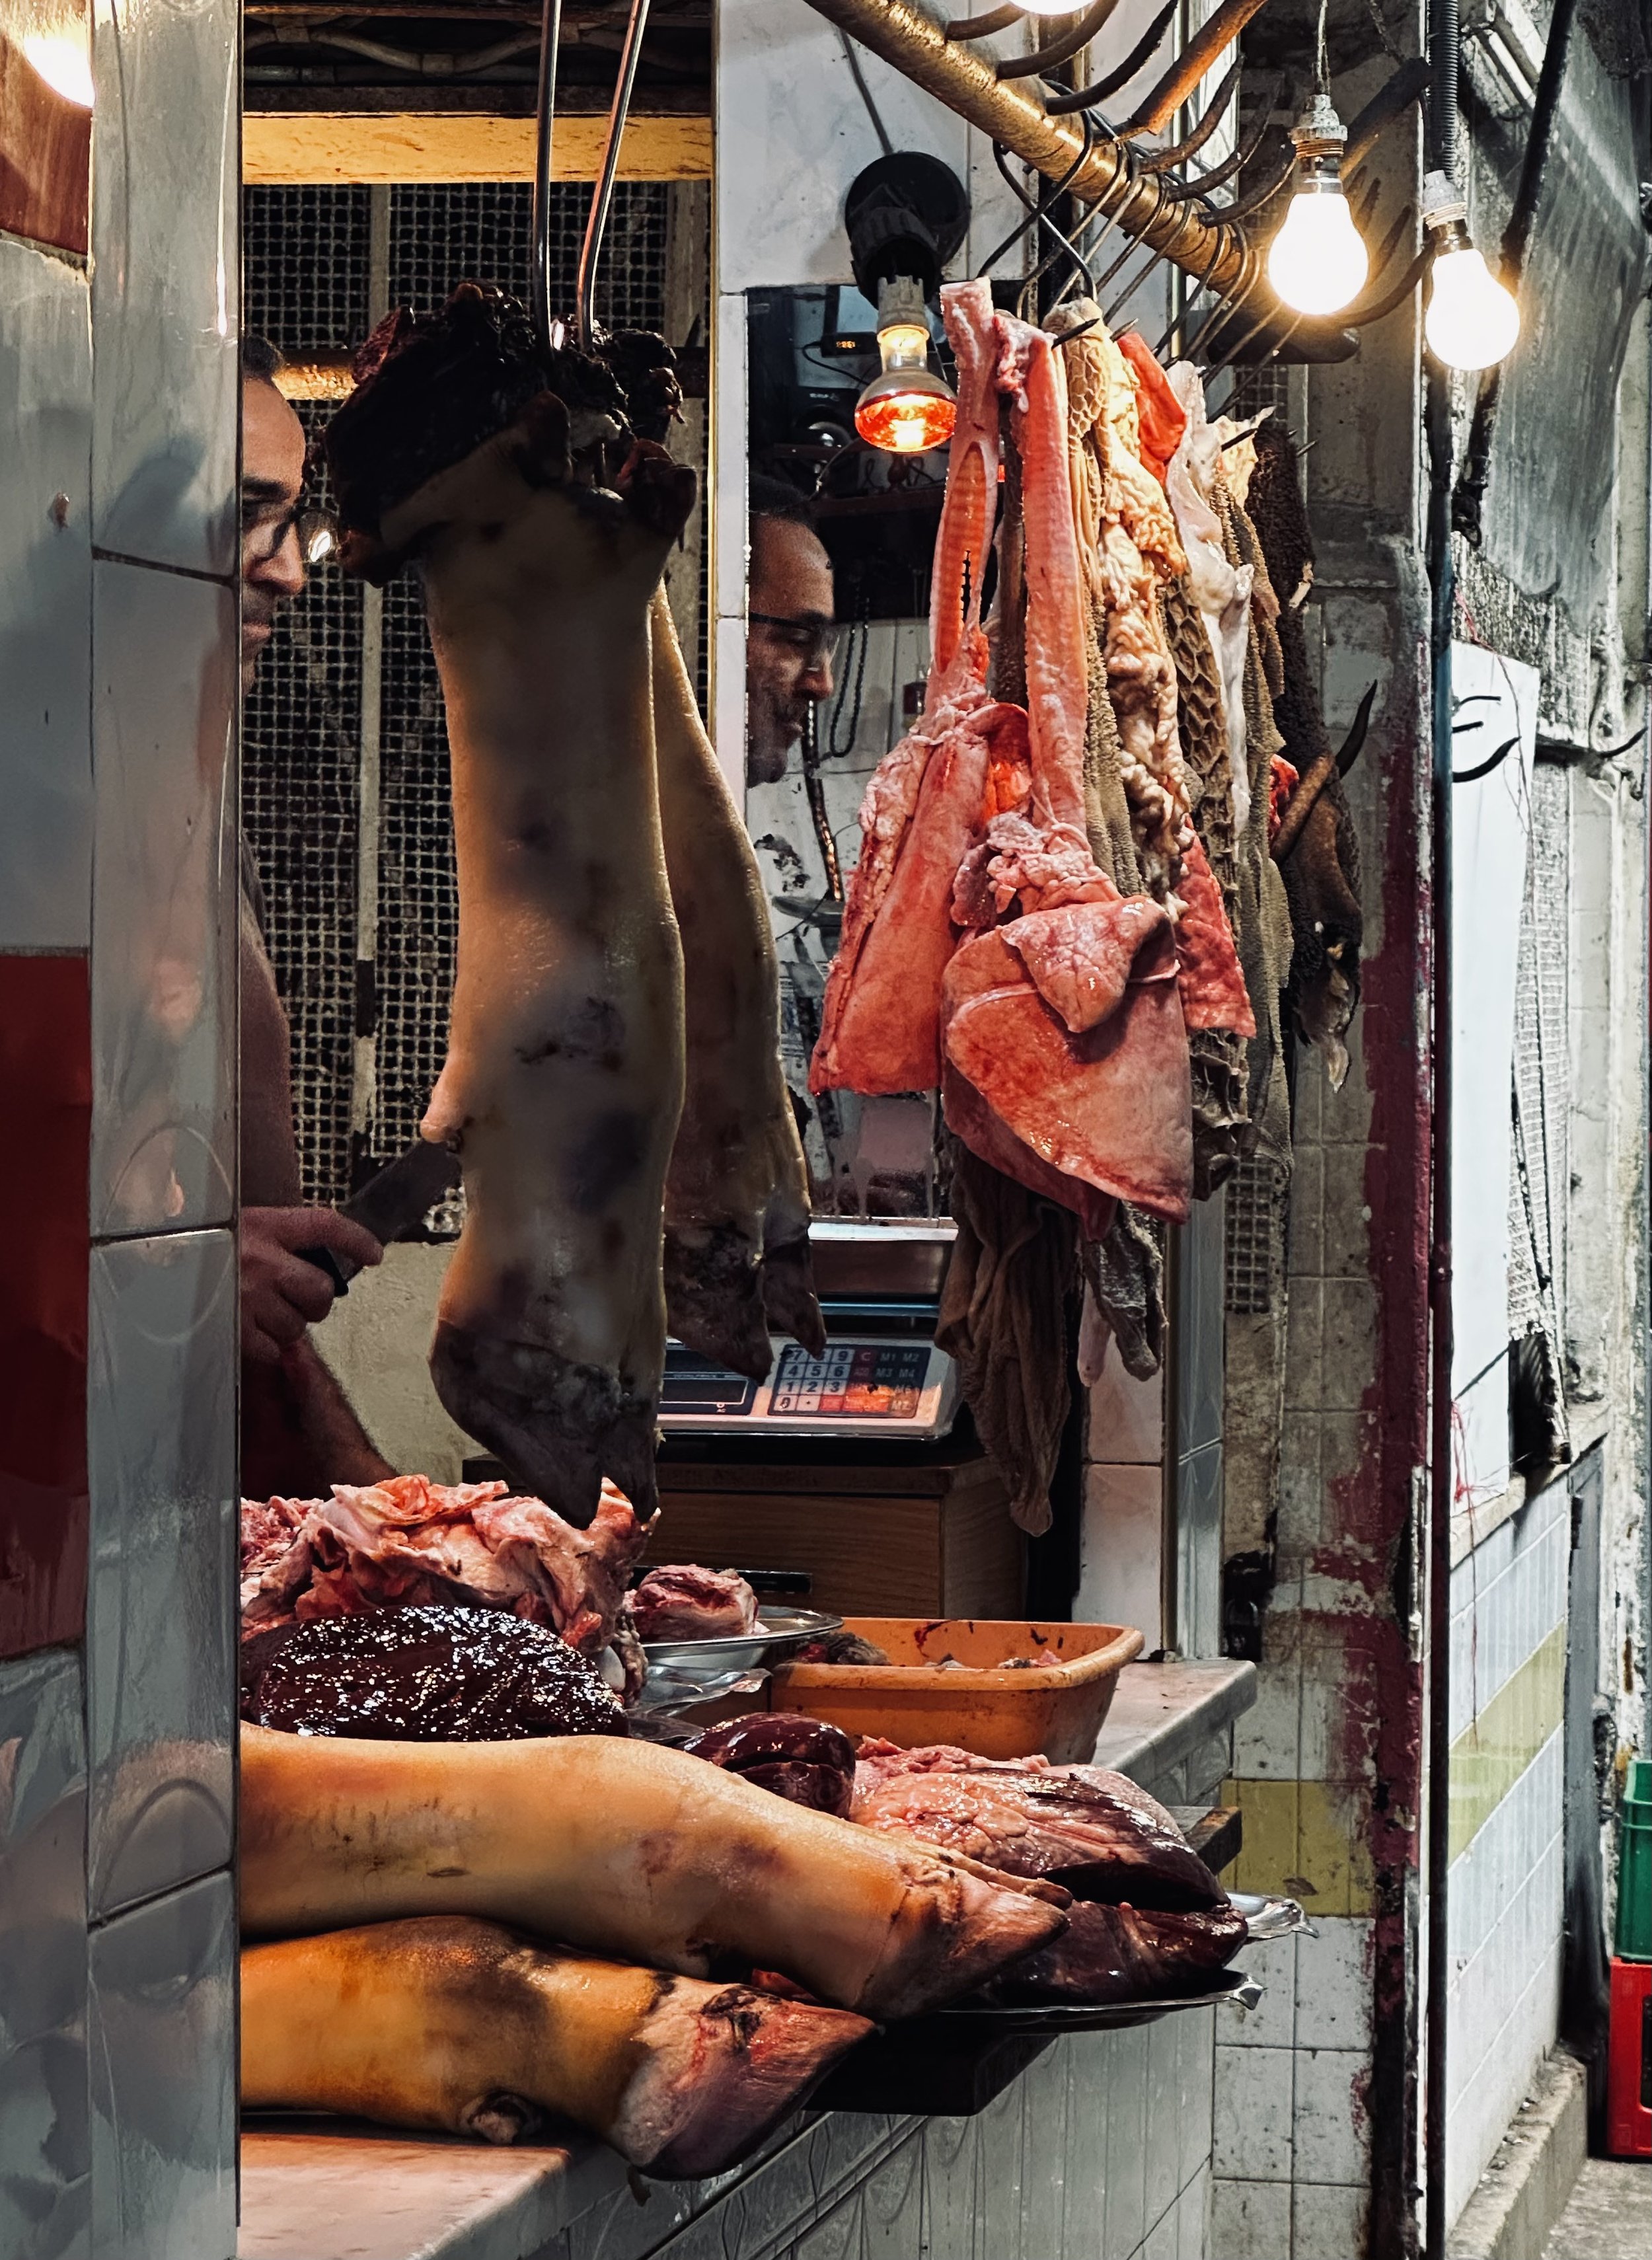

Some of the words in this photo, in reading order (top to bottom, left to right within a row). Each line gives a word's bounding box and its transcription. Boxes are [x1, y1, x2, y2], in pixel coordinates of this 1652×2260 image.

[838, 1351, 848, 1361] 9
[861, 1352, 872, 1361] C
[880, 1352, 897, 1362] M1
[902, 1353, 920, 1362] M2
[788, 1365, 798, 1376] 4
[811, 1365, 821, 1376] 5
[834, 1365, 845, 1376] 6
[876, 1367, 893, 1377] M3
[898, 1368, 915, 1378] M4
[787, 1381, 794, 1392] 1
[806, 1381, 817, 1392] 2
[830, 1381, 841, 1392] 3
